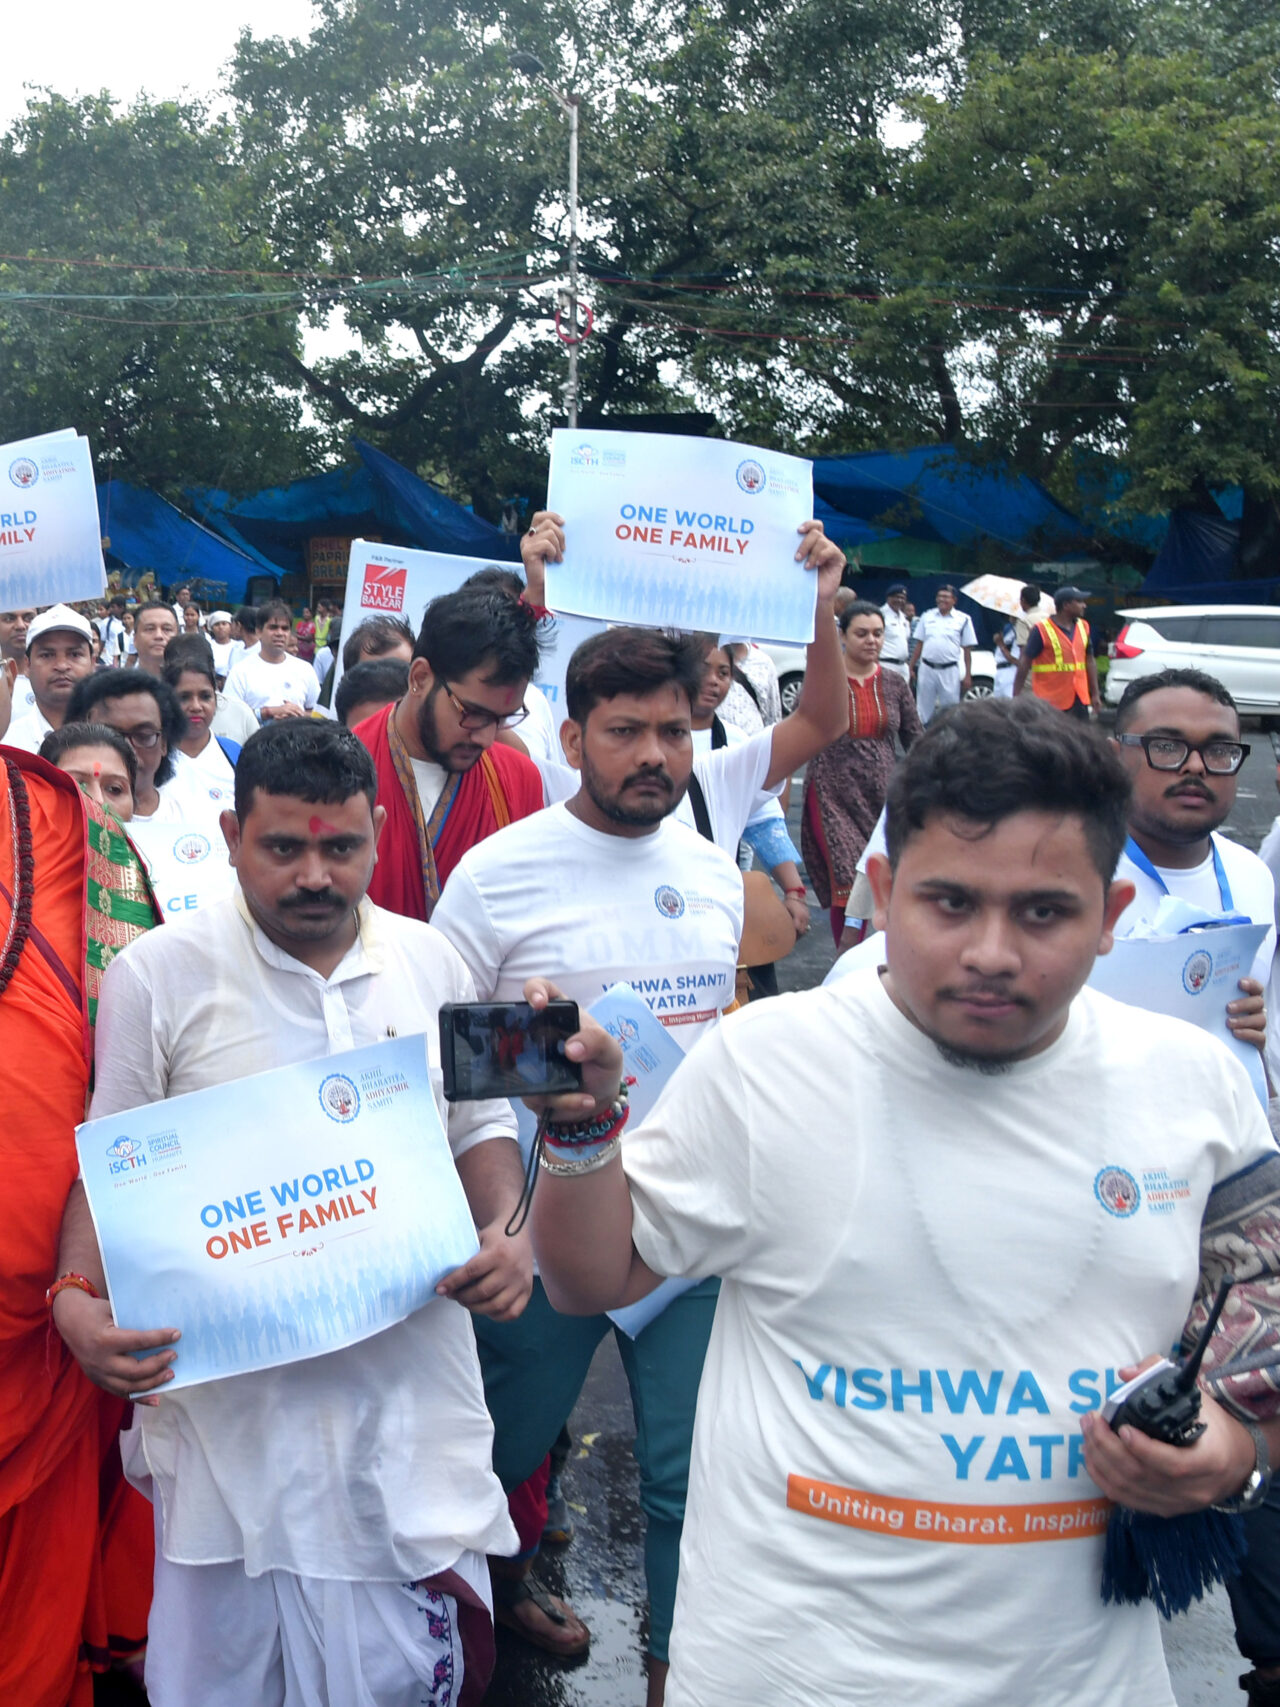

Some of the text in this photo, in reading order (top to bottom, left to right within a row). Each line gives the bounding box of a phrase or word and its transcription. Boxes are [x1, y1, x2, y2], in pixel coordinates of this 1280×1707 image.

[620, 504, 754, 535] ONE WORLD
[615, 524, 749, 555] ONE FAMILY
[363, 582, 404, 600] STYLE
[362, 595, 402, 609] BAAZAR
[676, 973, 726, 990] SHANTI
[645, 993, 697, 1010] YATRA
[360, 1068, 382, 1082] AKHIL
[361, 1072, 406, 1092] BHARATIYA
[365, 1081, 409, 1101] ADHYATMIK
[149, 1139, 180, 1153] COUNCIL
[1142, 1171, 1169, 1181] AKHIL
[200, 1158, 375, 1228] ONE WORLD
[205, 1186, 377, 1260] ONE FAMILY
[793, 1360, 1050, 1415] VISHWA
[808, 1488, 1111, 1534] Uniting Bharat. Inspirin
